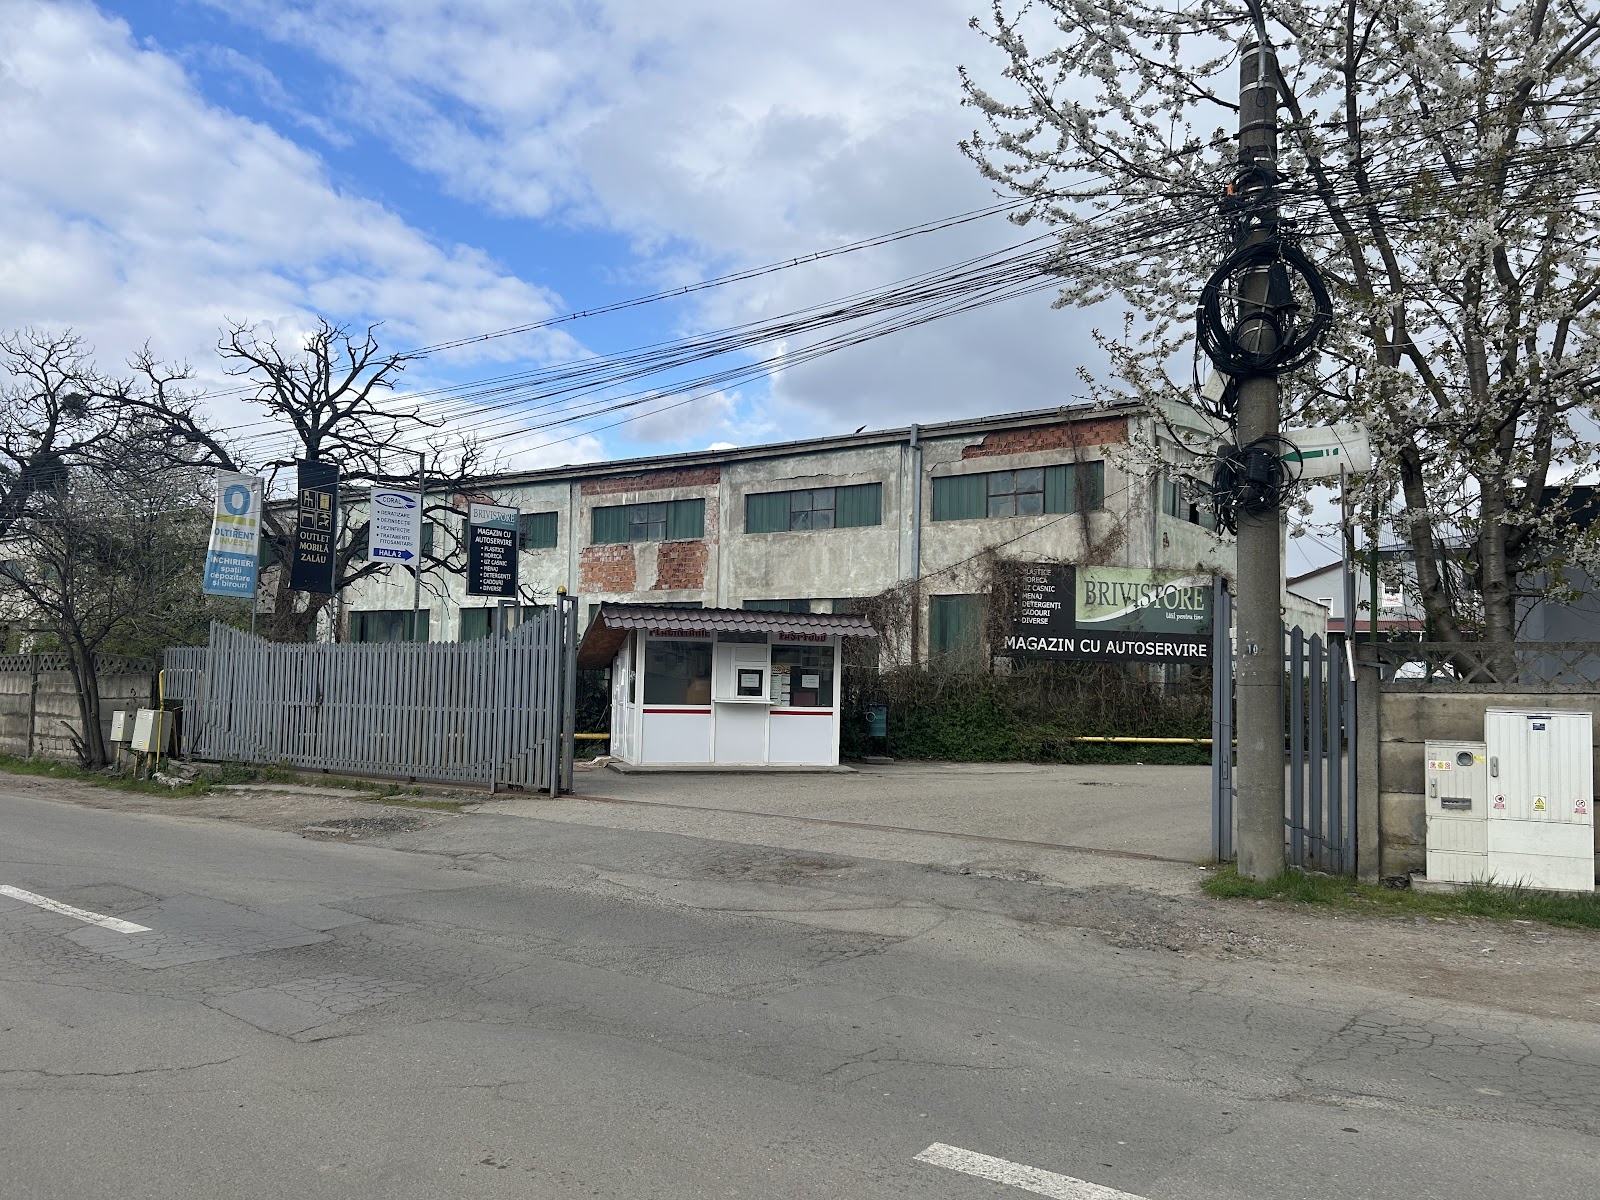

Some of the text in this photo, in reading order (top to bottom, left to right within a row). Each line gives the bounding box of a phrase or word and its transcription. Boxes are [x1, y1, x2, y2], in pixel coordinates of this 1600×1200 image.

[380, 510, 410, 518] DERATIZARE
[474, 509, 514, 522] BRIVISTORE
[215, 528, 254, 540] OLTIRENT
[300, 532, 330, 542] OUTLET
[477, 527, 502, 537] MAGAZIN
[220, 536, 249, 547] INVEST
[475, 536, 512, 546] AUTOSERVIRE
[299, 542, 329, 553] MOBILĂ
[301, 553, 326, 563] ZALĂU
[210, 572, 250, 581] depozitare
[1084, 581, 1205, 611] BRIVISTORE
[1004, 635, 1207, 657] MAGAZIN CU AUTOSERVIRE
